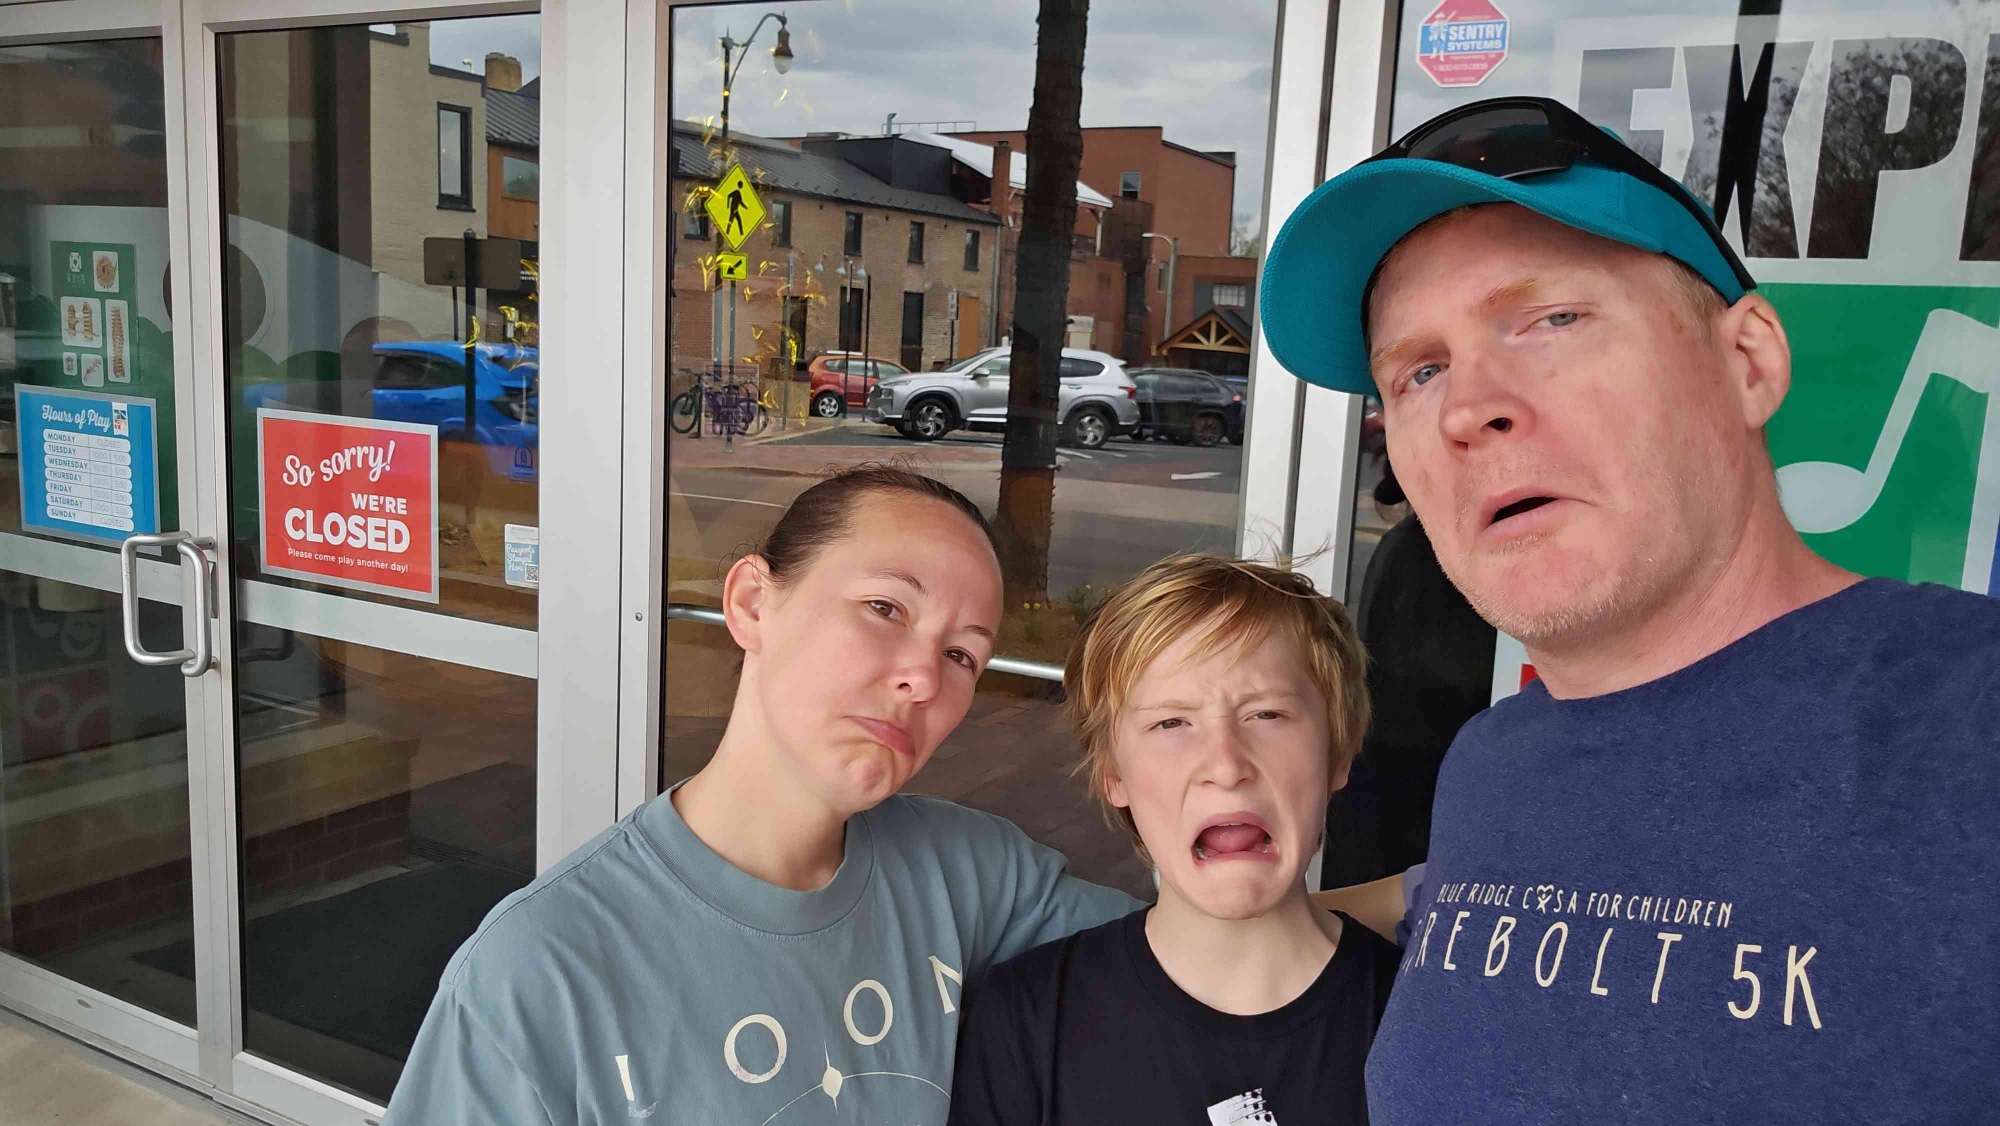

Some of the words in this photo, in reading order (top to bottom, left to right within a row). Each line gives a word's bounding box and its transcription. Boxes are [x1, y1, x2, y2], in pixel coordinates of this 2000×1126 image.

[1448, 24, 1504, 41] SENTRY
[1447, 40, 1502, 51] SYSTEMS
[1576, 34, 2000, 261] EXP
[42, 404, 73, 422] Hours
[74, 410, 87, 429] of
[87, 409, 111, 432] Play
[48, 433, 75, 443] MONDAY
[48, 445, 76, 455] TUESDAY
[48, 458, 88, 469] WEDNESDAY
[282, 454, 315, 487] So
[319, 440, 396, 482] sorry!
[49, 471, 82, 482] THURSDAY
[50, 484, 72, 493] FRIDAY
[50, 496, 83, 508] SATURDAY
[352, 492, 408, 515] WE'RE
[51, 508, 76, 519] SUNDAY
[284, 507, 411, 554] CLOSED
[288, 547, 313, 560] Please
[314, 551, 336, 562] come
[338, 555, 355, 566] play
[356, 558, 389, 571] another
[391, 561, 409, 574] day!
[1467, 883, 1515, 908] RIDGE
[1585, 892, 1621, 919] FOR
[1626, 895, 1733, 929] CHILDREN
[1727, 943, 1822, 1029] 5K
